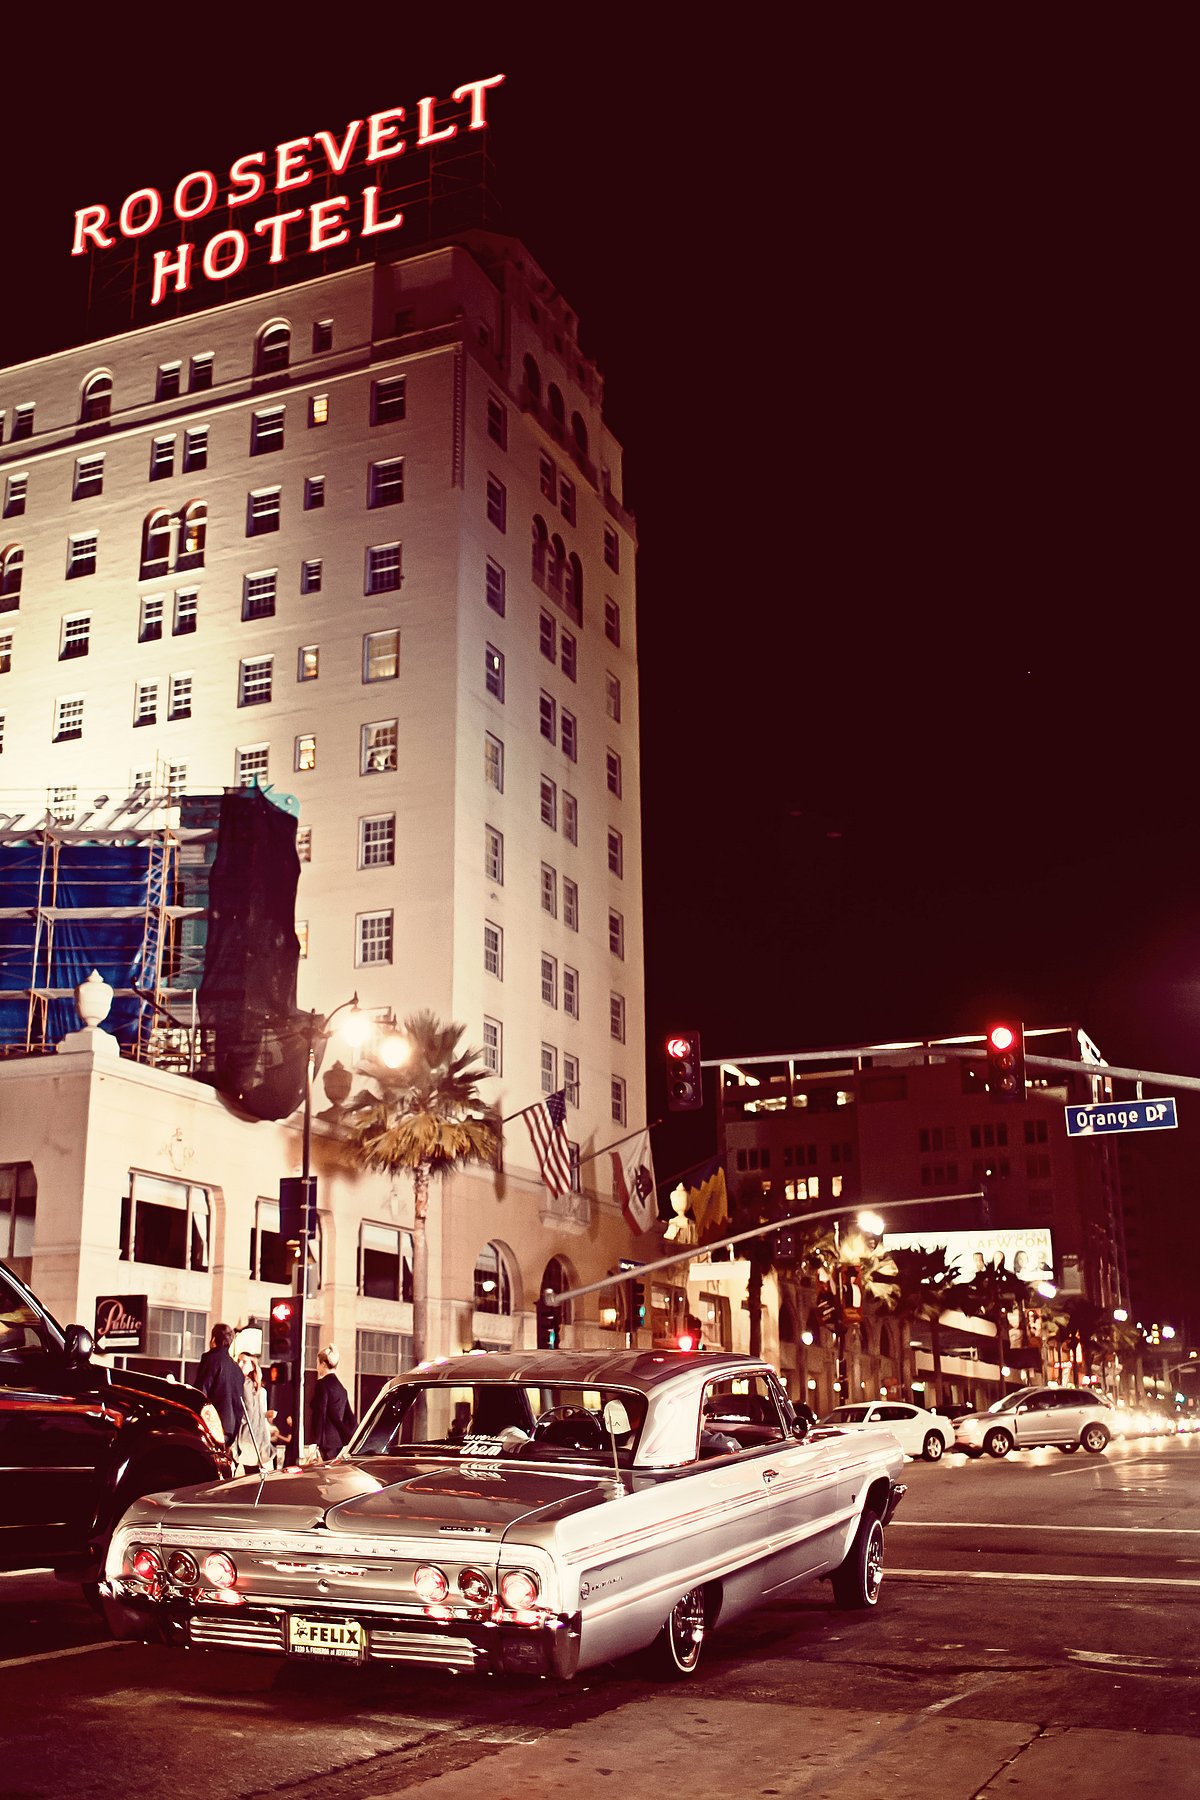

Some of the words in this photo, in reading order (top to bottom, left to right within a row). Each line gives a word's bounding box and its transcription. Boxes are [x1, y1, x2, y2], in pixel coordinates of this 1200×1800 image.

[71, 73, 506, 256] ROOSEVELT
[150, 186, 404, 306] HOTEL
[1076, 1110, 1138, 1128] Orange
[97, 1299, 142, 1335] Public
[460, 1440, 503, 1456] them
[310, 1627, 358, 1644] FELIX
